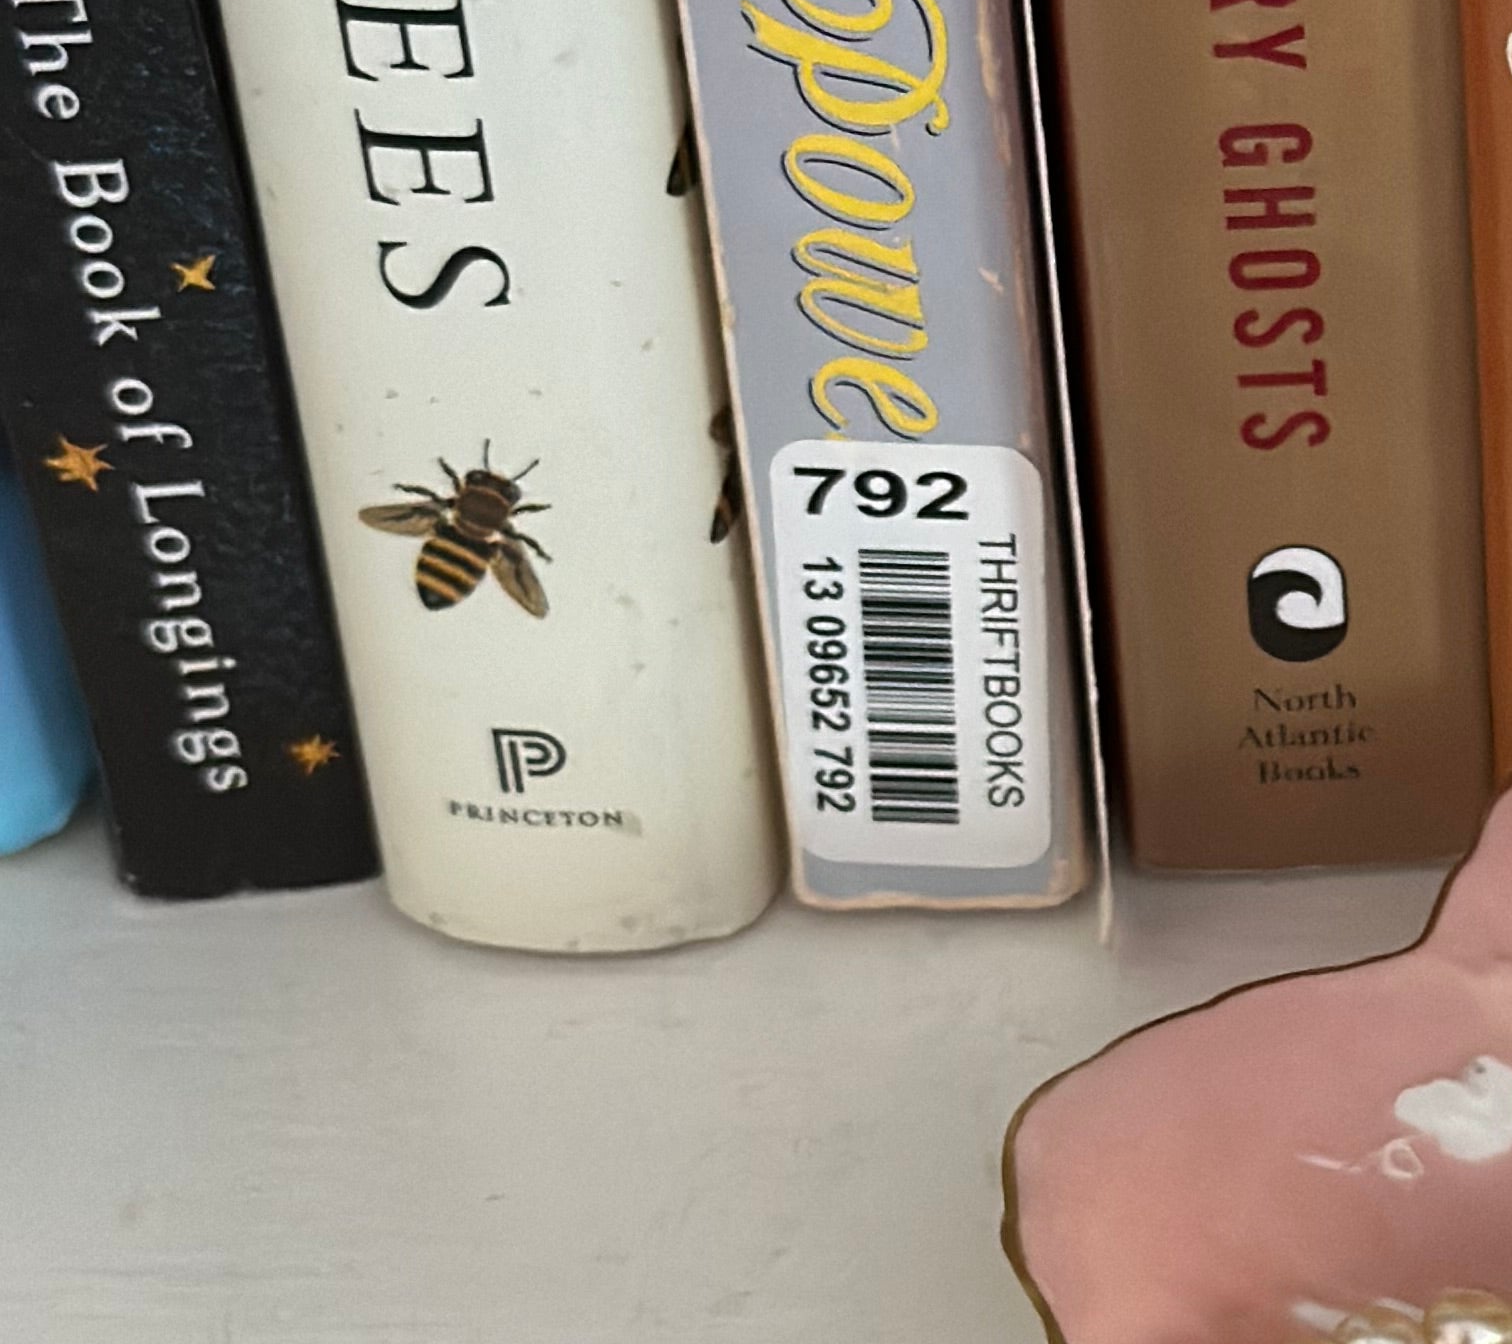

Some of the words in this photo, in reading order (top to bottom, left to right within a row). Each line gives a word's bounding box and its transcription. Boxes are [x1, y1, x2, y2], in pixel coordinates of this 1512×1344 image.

[54, 159, 162, 347] Book
[1217, 122, 1331, 452] GHOSTS
[109, 378, 192, 450] of
[793, 467, 969, 520] 792
[803, 556, 844, 601] 13
[130, 480, 248, 793] Longings
[807, 616, 851, 732] 09652
[978, 533, 1025, 809] THRIFTBOOKS
[1253, 685, 1358, 714] North
[1238, 718, 1376, 749] Atlantic
[814, 746, 857, 813] 792
[1257, 755, 1362, 786] Books
[448, 800, 626, 830] PRINCETON
